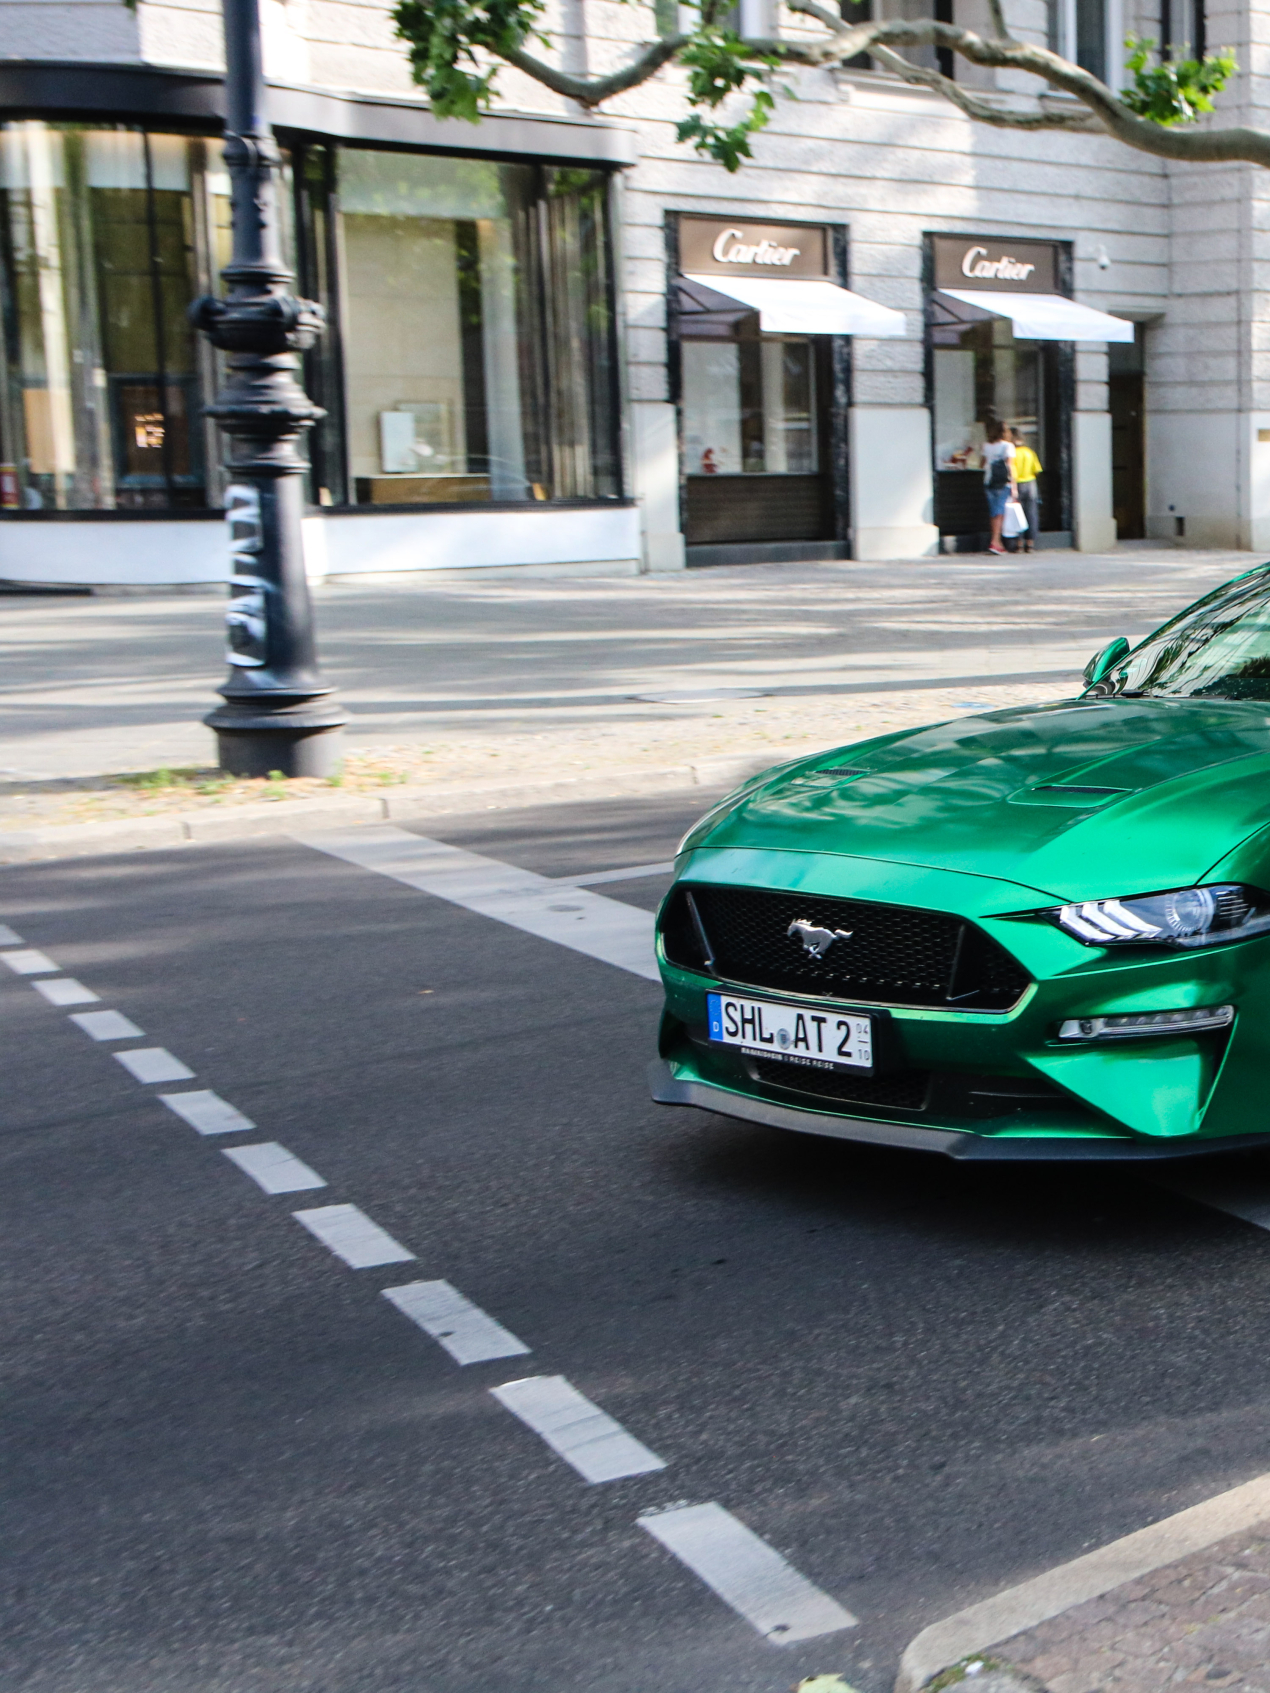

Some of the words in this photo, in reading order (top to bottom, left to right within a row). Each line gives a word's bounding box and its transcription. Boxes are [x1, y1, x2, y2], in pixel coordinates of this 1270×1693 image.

[712, 228, 801, 267] Cartier
[962, 246, 1036, 281] Cartier
[724, 1001, 775, 1044] SHL
[794, 1012, 828, 1053] AT
[836, 1019, 853, 1058] 2
[857, 1048, 870, 1061] 10
